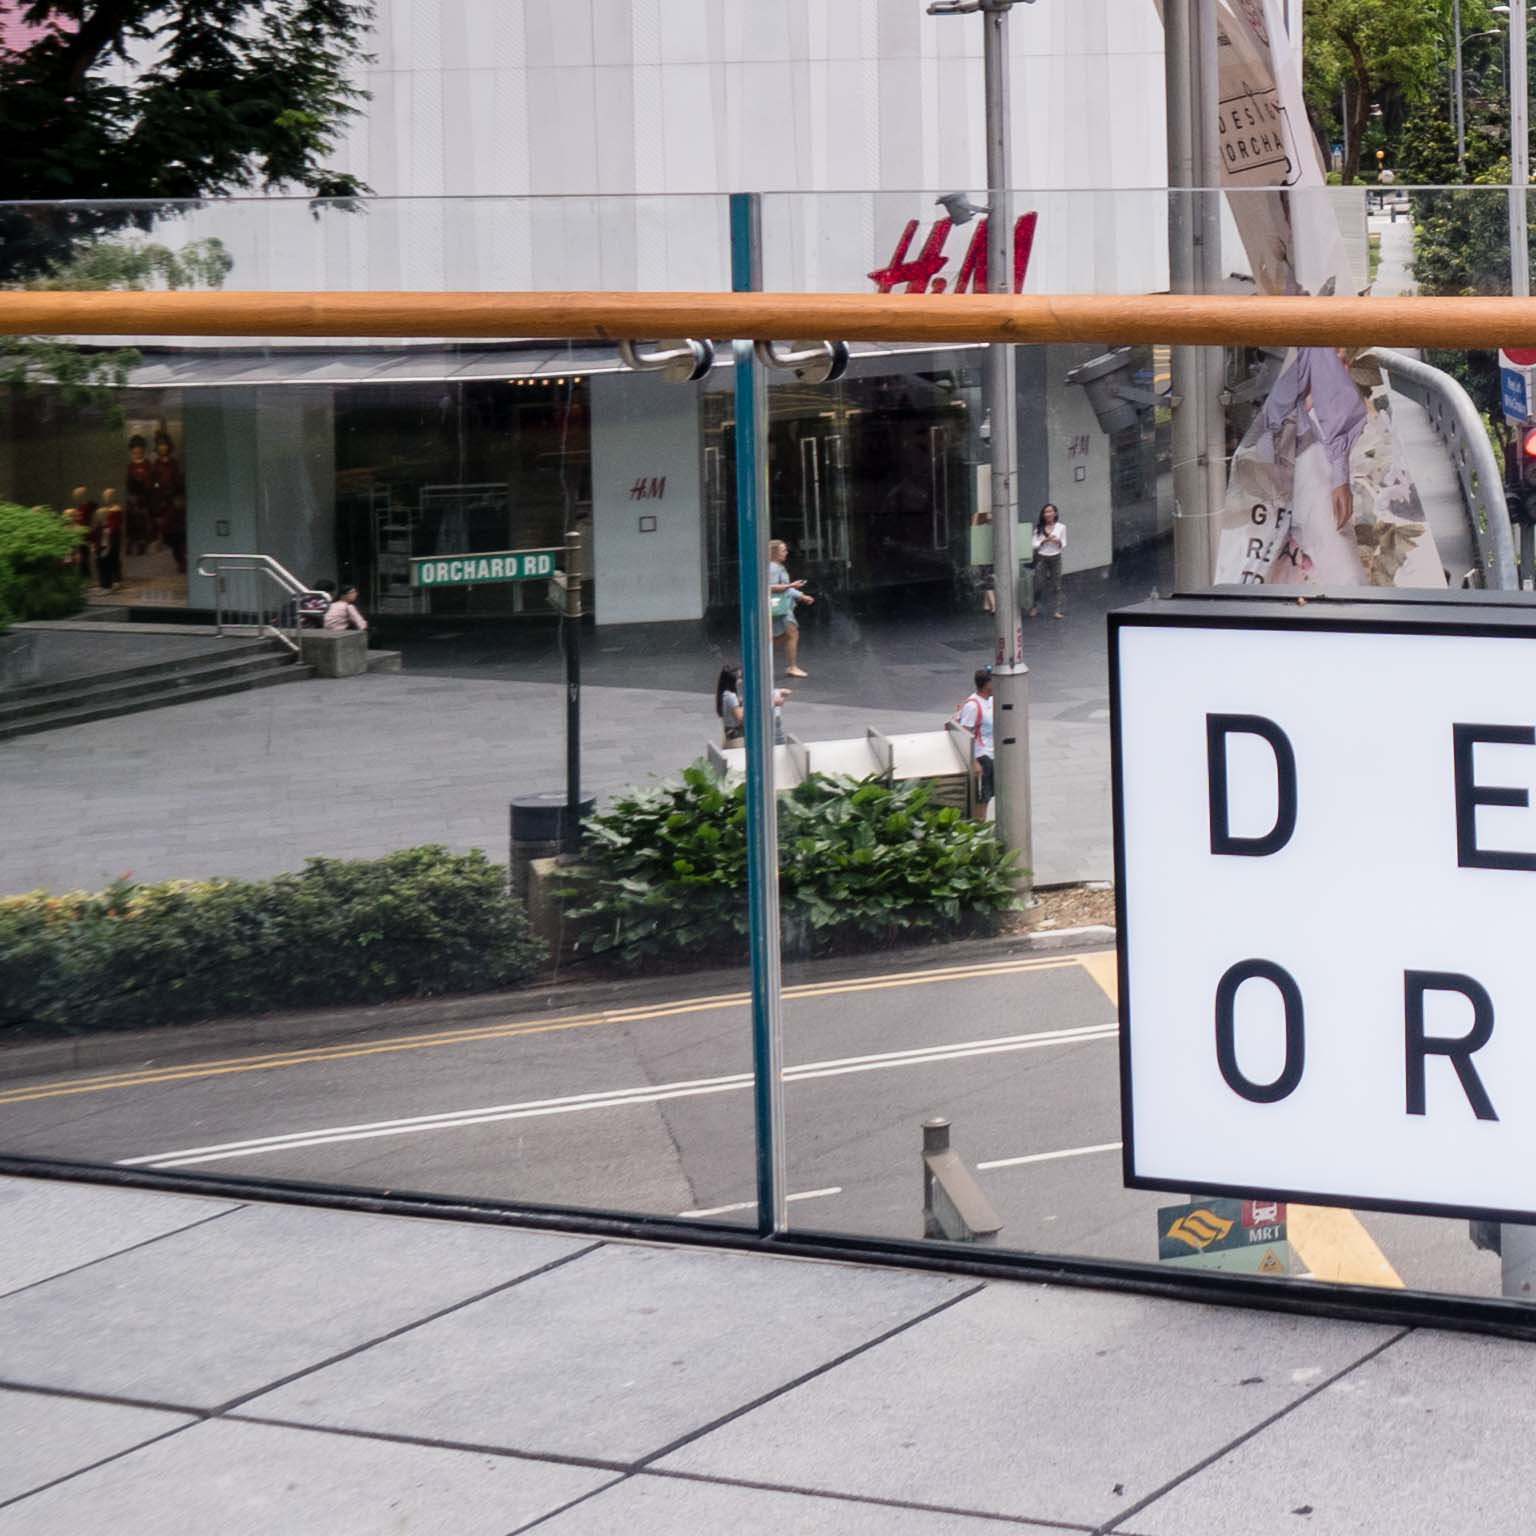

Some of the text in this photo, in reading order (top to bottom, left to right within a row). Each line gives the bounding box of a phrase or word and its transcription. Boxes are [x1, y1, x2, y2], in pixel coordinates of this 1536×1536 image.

[1226, 130, 1283, 163] ORCHA
[867, 212, 1038, 294] HM
[629, 475, 667, 501] H&M
[422, 554, 551, 583] ORCHARD RD
[1249, 1225, 1280, 1243] MRT
